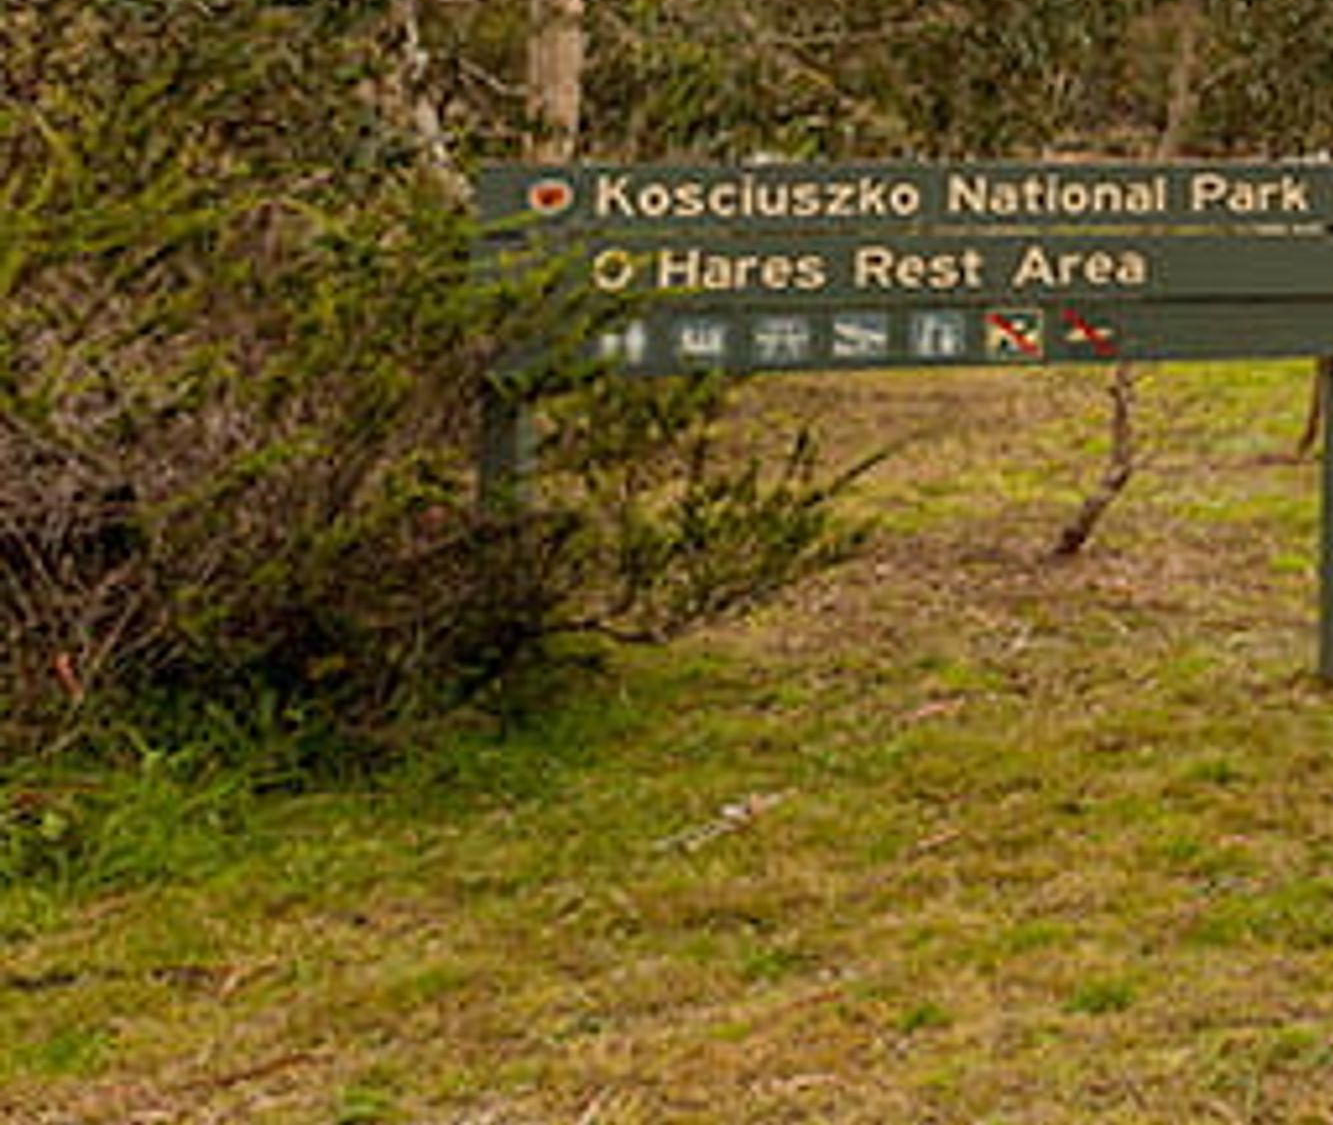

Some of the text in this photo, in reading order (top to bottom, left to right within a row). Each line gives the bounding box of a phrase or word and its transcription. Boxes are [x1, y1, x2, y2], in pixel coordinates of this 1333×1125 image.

[596, 172, 1310, 217] Kosciuszko National Park
[856, 245, 983, 289] Rest
[1012, 245, 1146, 288] Area
